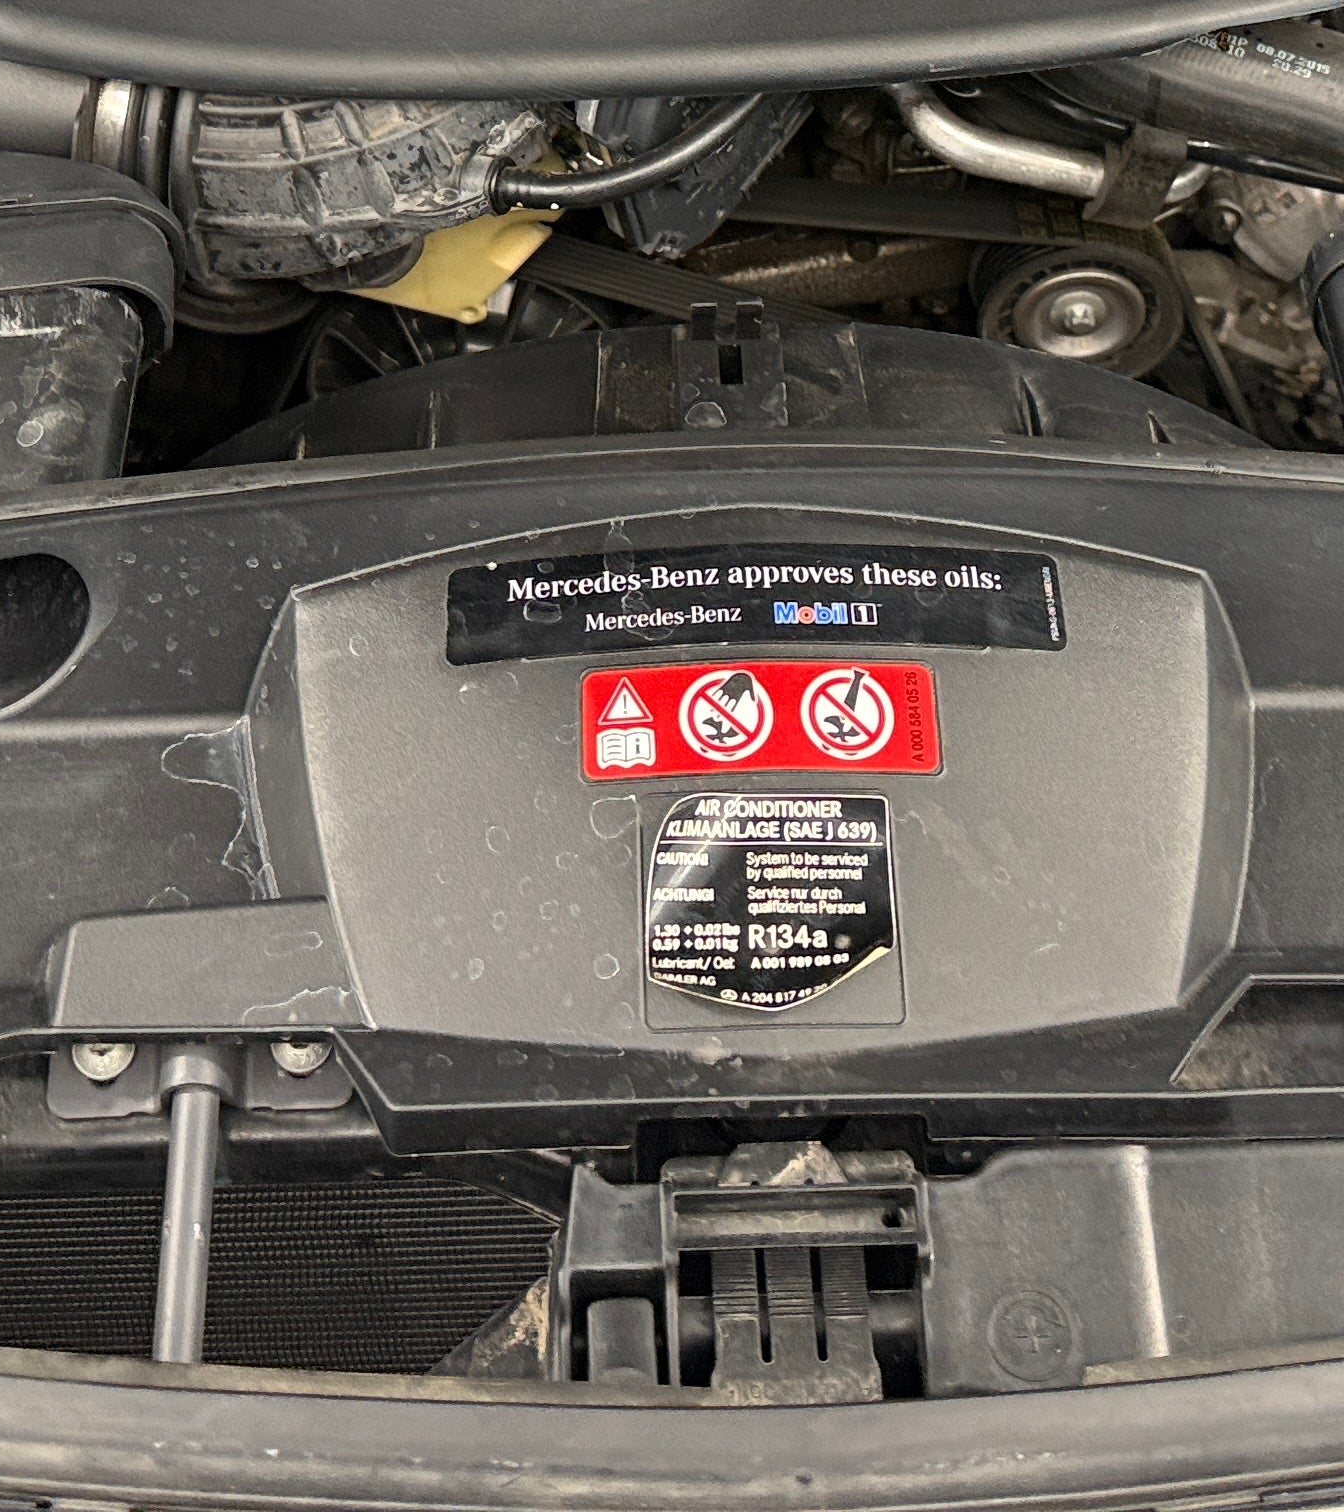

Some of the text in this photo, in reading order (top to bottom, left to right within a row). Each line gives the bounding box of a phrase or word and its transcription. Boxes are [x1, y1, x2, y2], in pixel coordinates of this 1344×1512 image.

[506, 561, 1003, 603] Mercedes-Benz approves these oils:
[583, 604, 743, 633] Mercedes-Benz
[772, 601, 849, 626] Mobil
[694, 799, 843, 819] AIR CONDITIONER
[665, 819, 878, 843] KLIMAANLAGE (SAE J 639)
[745, 851, 869, 868] System to be serviced
[746, 866, 863, 882] by qualified personnel
[747, 885, 843, 900] Service nur durch
[747, 900, 867, 916] qualifiziertes Personal
[748, 923, 829, 950] R134a
[750, 956, 762, 969] A
[699, 975, 717, 987] AG
[741, 991, 751, 1002] A
